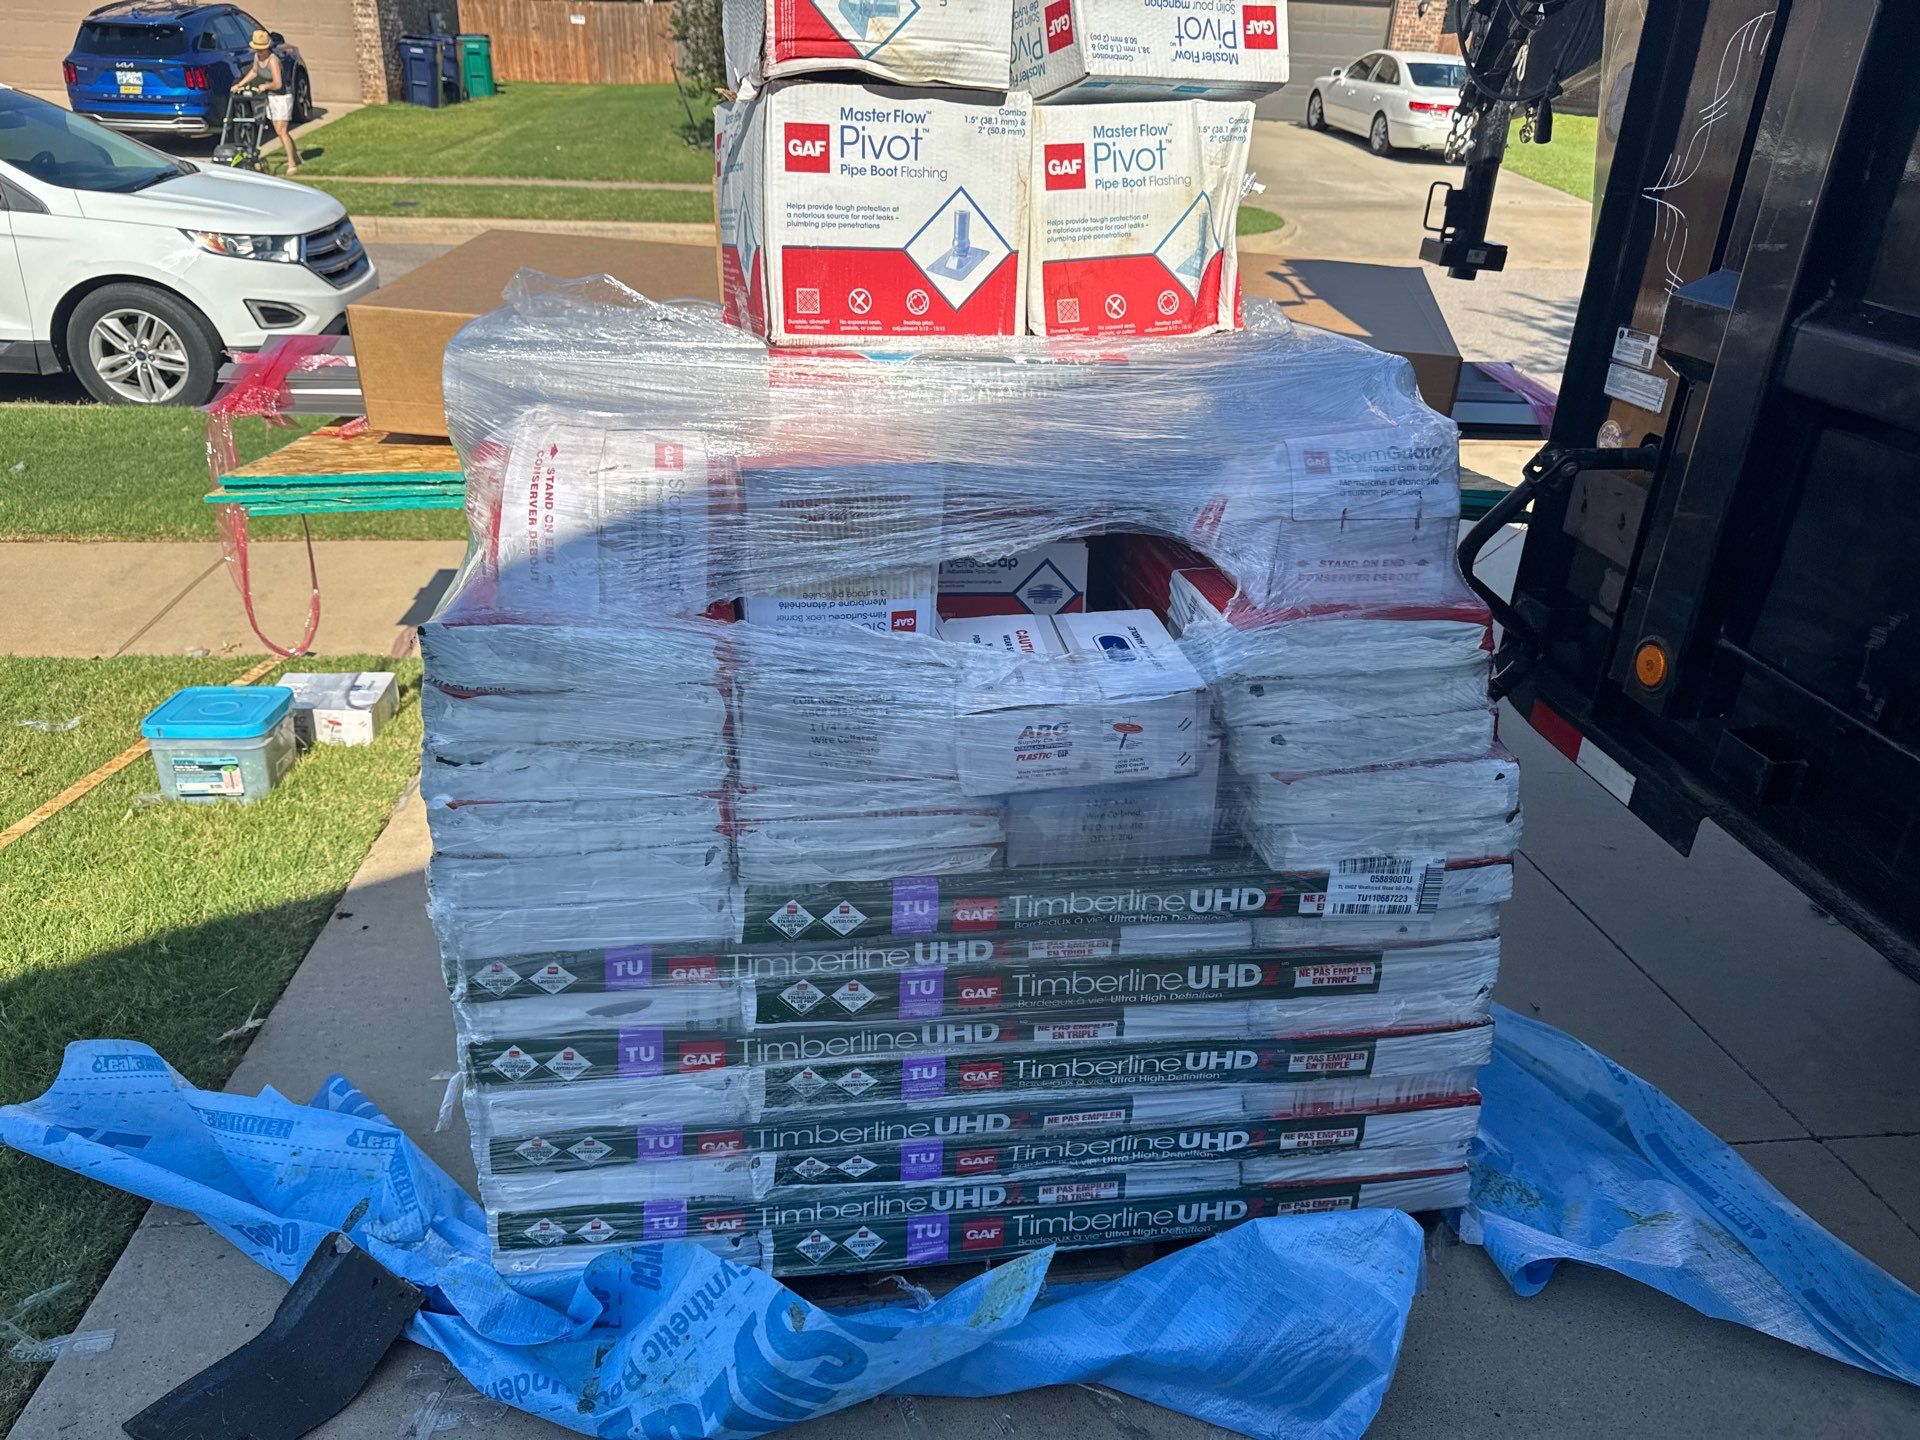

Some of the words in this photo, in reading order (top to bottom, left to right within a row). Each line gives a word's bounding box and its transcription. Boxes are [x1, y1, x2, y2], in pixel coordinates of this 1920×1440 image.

[1193, 0, 1214, 11] pour
[1215, 2, 1236, 14] Solin
[1048, 13, 1071, 37] GAF
[1245, 20, 1275, 36] GAF
[1092, 52, 1134, 62] Combinaison
[998, 108, 1027, 117] Combo
[980, 117, 999, 127] (38.1
[1000, 117, 1018, 127] mm)
[987, 127, 1006, 137] (50.8
[1007, 128, 1026, 137] mm)
[788, 139, 827, 157] GAF
[840, 164, 867, 178] Pipe
[870, 164, 898, 178] Boot
[900, 165, 949, 182] Flashing
[1048, 158, 1082, 175] GAF
[1095, 178, 1120, 191] Pipe
[1122, 177, 1147, 187] Boot
[1149, 174, 1192, 188] Flashing
[786, 202, 806, 212] Helps
[807, 203, 834, 213] provide
[835, 204, 855, 214] tough
[856, 205, 891, 214] protection
[786, 220, 820, 229] plumbing
[821, 221, 837, 229] pipe
[838, 221, 881, 230] penetrations
[1047, 219, 1064, 227] Helps
[1065, 217, 1089, 226] provide
[1090, 216, 1109, 225] tough
[1109, 215, 1141, 224] protection
[1047, 235, 1076, 243] plumbing
[1093, 232, 1132, 240] penetrations
[528, 449, 545, 526] CONSERVER
[544, 467, 556, 511] STAND
[1319, 559, 1360, 569] STAND
[1362, 559, 1379, 568] ON
[1382, 559, 1406, 568] END
[838, 599, 887, 607] Membrane
[776, 615, 804, 624] Barrier
[893, 617, 915, 627] GAF
[1016, 752, 1053, 761] PLASTIC
[900, 900, 930, 915] TU
[1009, 889, 1186, 919] Timberline
[956, 908, 994, 921] GAF
[1109, 914, 1138, 923] Ultra
[728, 941, 910, 977] Timberline
[613, 960, 644, 976] TU
[672, 968, 712, 980] GAF
[1300, 967, 1313, 977] NE
[1314, 967, 1332, 977] PAS
[1333, 965, 1373, 976] EMPILER
[1013, 969, 1183, 998] Timberline
[1312, 976, 1325, 985] EN
[1326, 975, 1358, 985] TRIPLE
[907, 980, 936, 995] TU
[961, 987, 999, 999] GAF
[1111, 995, 1137, 1004] Ultra
[1140, 993, 1168, 1003] High
[1170, 991, 1223, 1001] Definition
[1052, 1031, 1064, 1040] EN
[1066, 1029, 1099, 1039] TRIPLE
[736, 1027, 917, 1063] Timberline
[626, 1047, 655, 1062] TU
[683, 1053, 722, 1065] GAF
[1293, 1055, 1306, 1063] NE
[1308, 1054, 1326, 1063] PAS
[1328, 1052, 1366, 1062] EMPILER
[99, 1055, 140, 1072] Leak
[1013, 1054, 1181, 1080] Timberline
[1305, 1062, 1319, 1070] EN
[1319, 1060, 1351, 1070] TRIPLE
[909, 1067, 937, 1080] TU
[962, 1072, 999, 1083] GAF
[1109, 1075, 1135, 1085] Ultra
[1138, 1074, 1165, 1084] High
[1168, 1072, 1221, 1082] Definition
[1047, 1117, 1060, 1125] NE
[1062, 1115, 1080, 1124] PAS
[1083, 1112, 1122, 1122] EMPILER
[356, 1129, 398, 1149] Lea
[753, 1122, 930, 1149] Timberline
[1298, 1131, 1315, 1140] PAS
[1317, 1129, 1355, 1139] EMPILER
[645, 1135, 675, 1149] TU
[1009, 1135, 1176, 1163] Timberline
[908, 1152, 935, 1165] TU
[959, 1155, 995, 1166] GAF
[1102, 1155, 1130, 1165] Ultra
[1132, 1152, 1159, 1162] High
[1056, 1185, 1075, 1194] PAS
[1077, 1182, 1116, 1192] EMPILER
[756, 1196, 928, 1226] Timberline
[651, 1217, 679, 1229] TU
[1013, 1206, 1174, 1237] Timberline
[914, 1223, 942, 1239] TU
[965, 1228, 1001, 1240] GAF
[1018, 1235, 1072, 1247] Bardeaux
[1105, 1229, 1131, 1239] Ultra
[1133, 1228, 1159, 1238] High
[1160, 1225, 1213, 1235] Definition
